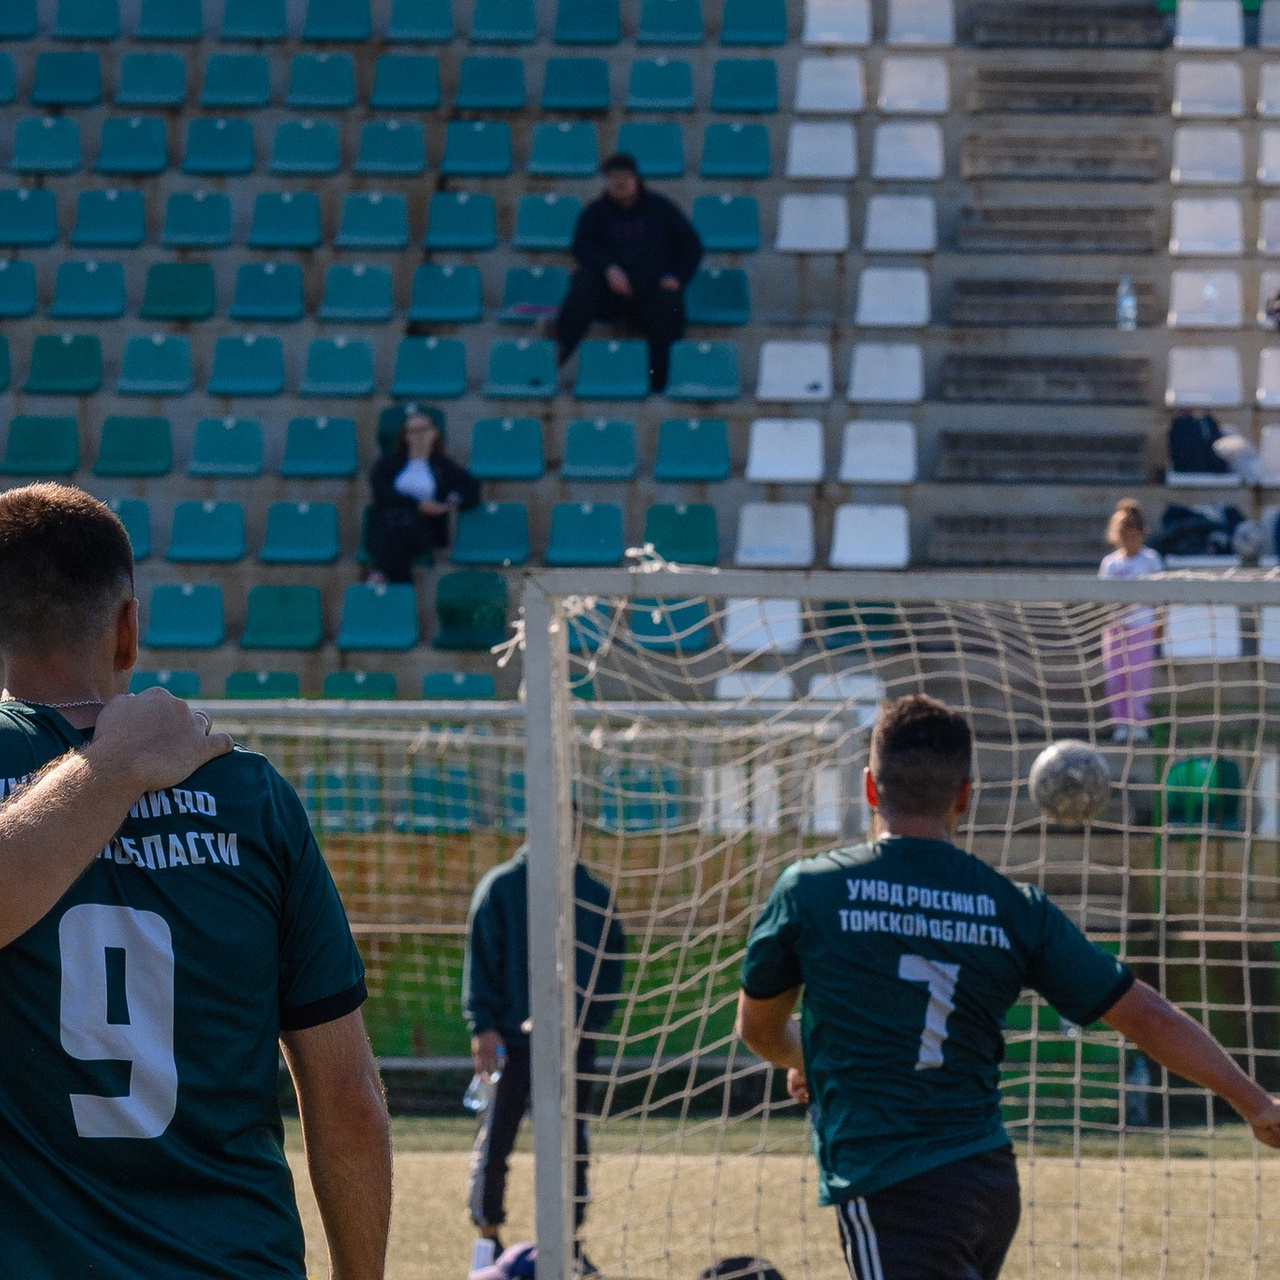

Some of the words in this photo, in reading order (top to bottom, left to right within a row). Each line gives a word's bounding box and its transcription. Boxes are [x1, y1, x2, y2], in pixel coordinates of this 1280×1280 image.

[838, 909, 928, 937] ТОМСКОЙ
[846, 879, 904, 908] УМВД
[906, 886, 974, 915] РОССИИ
[58, 903, 178, 1139] 9
[898, 954, 961, 1071] 7
